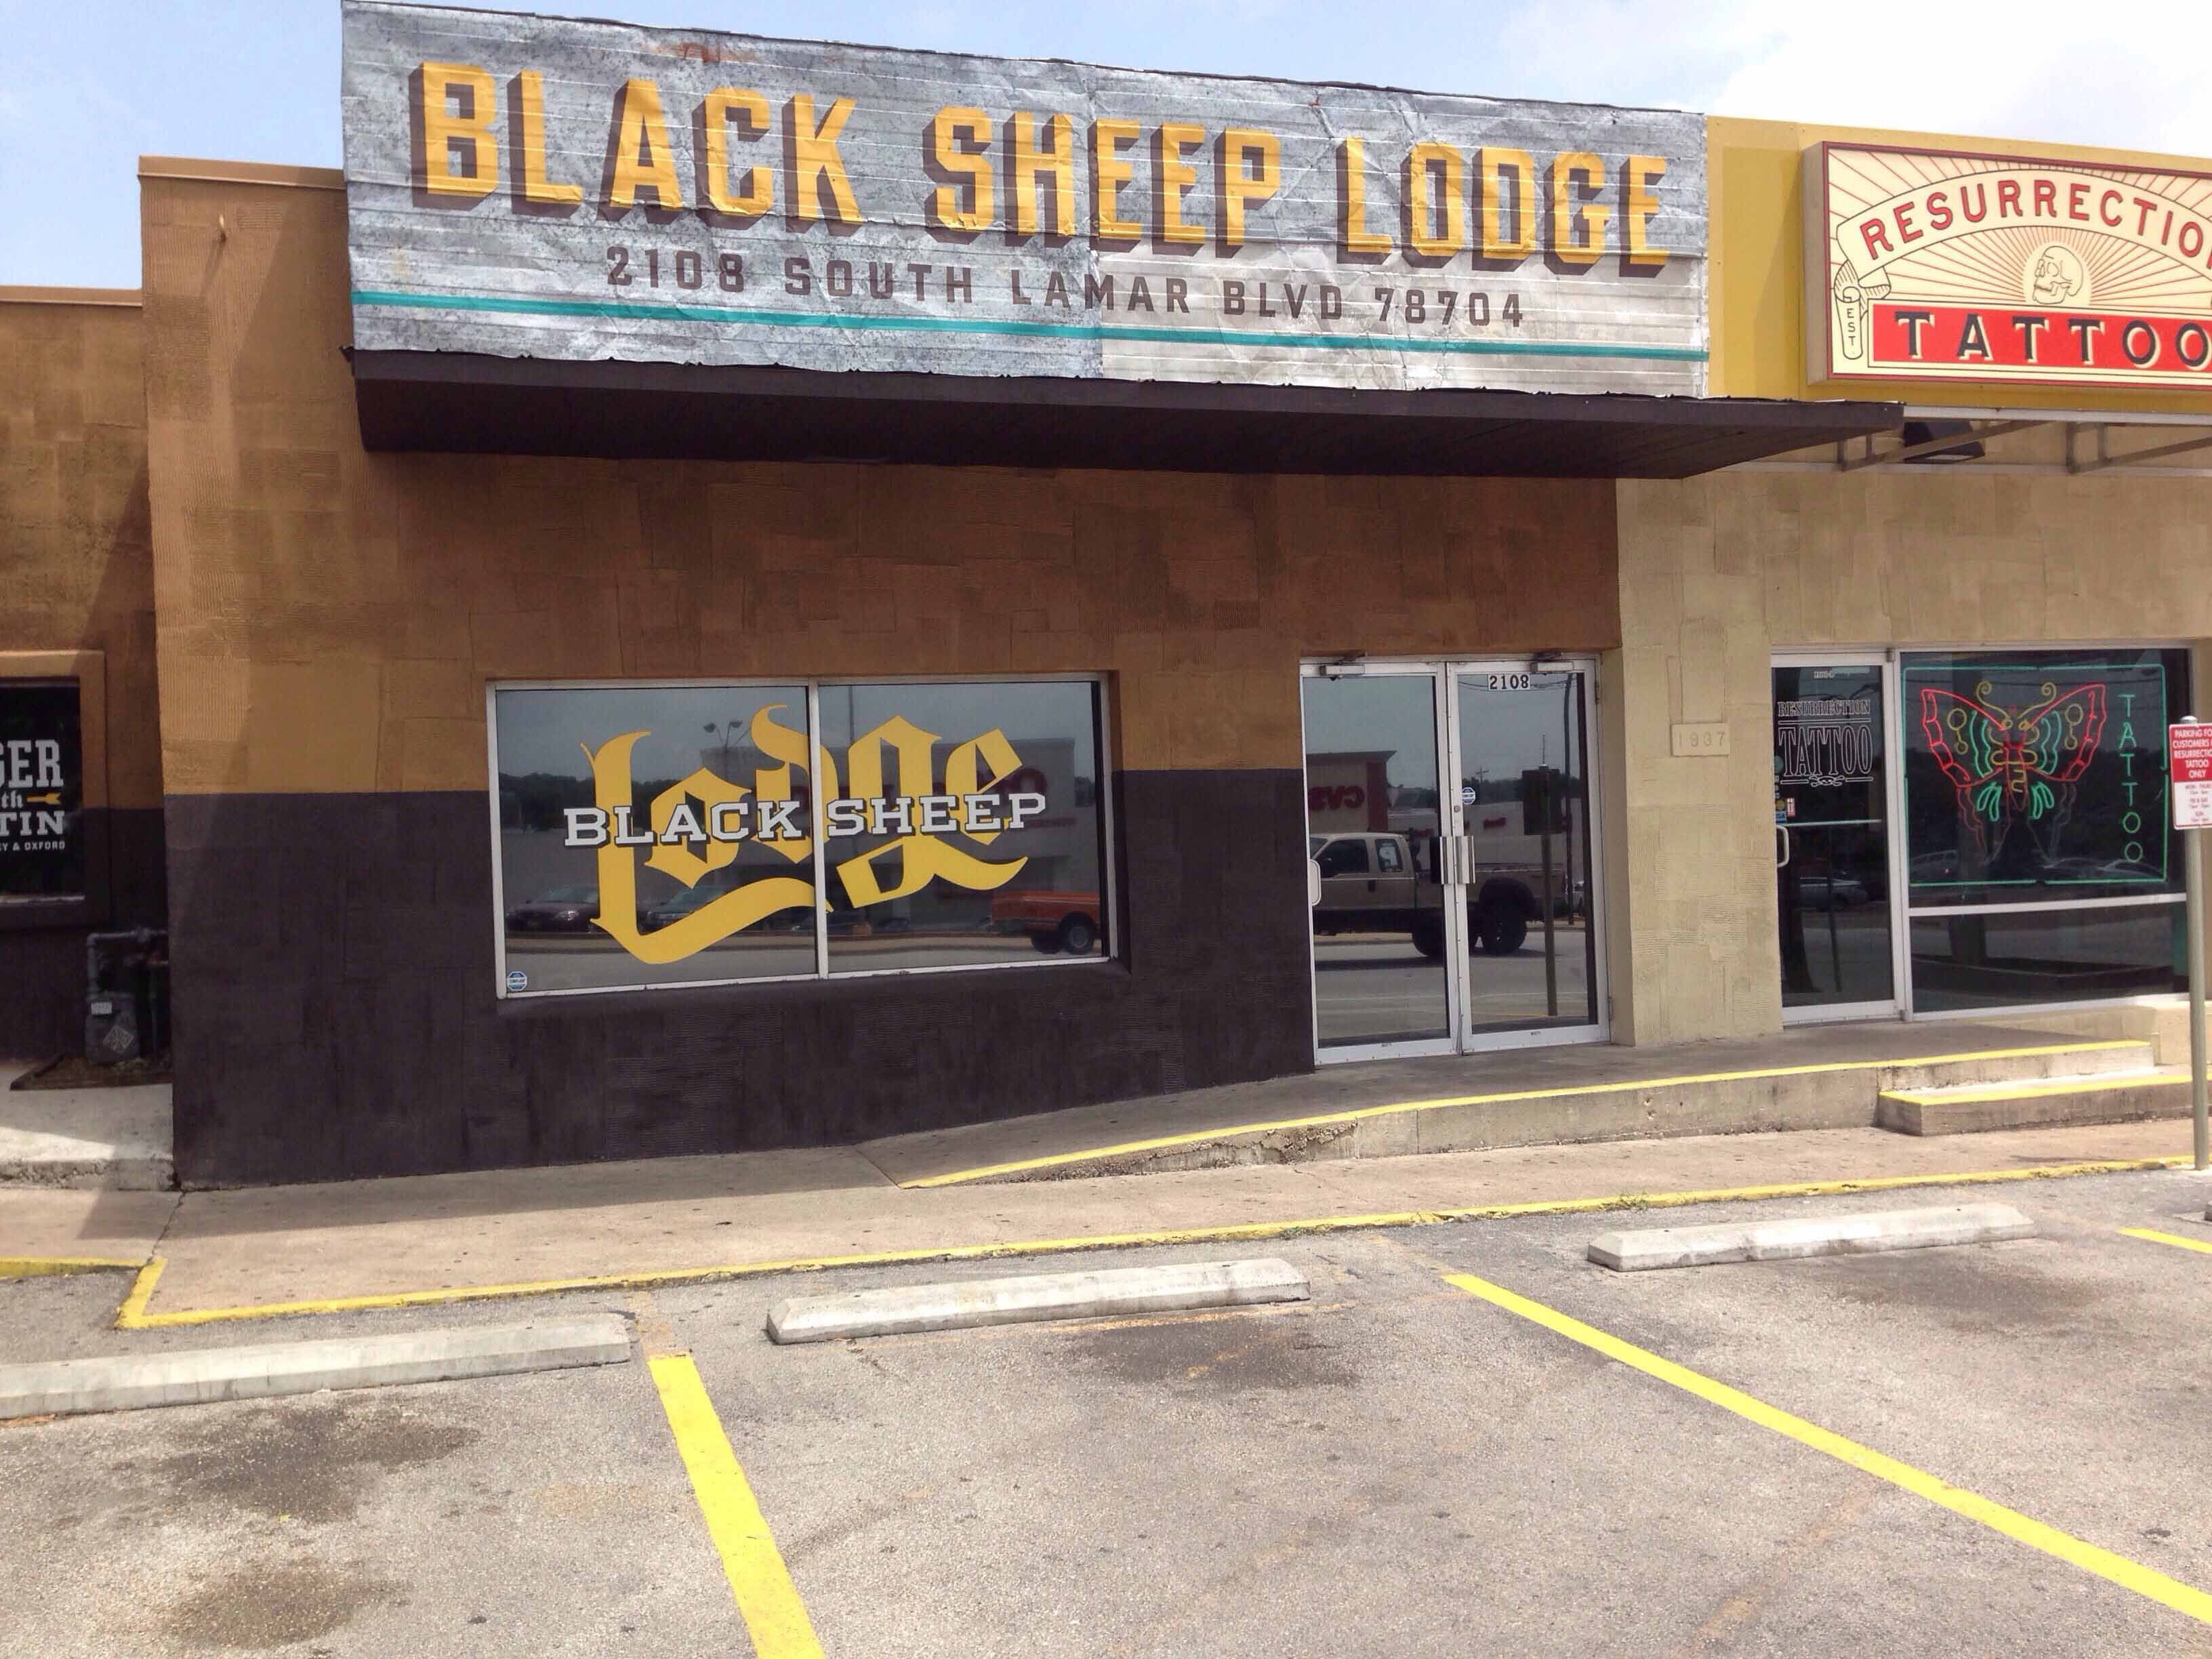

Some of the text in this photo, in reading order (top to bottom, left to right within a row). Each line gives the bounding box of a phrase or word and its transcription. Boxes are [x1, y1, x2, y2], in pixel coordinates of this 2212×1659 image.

[410, 62, 1669, 278] BLACK SHEEP LODGE
[1860, 179, 2212, 270] RESURRECTIO
[607, 246, 1523, 328] 2108 SOUTH LAMAR BLVD 78704
[1845, 308, 1856, 348] EST
[1894, 310, 2212, 371] TATTOO
[1490, 674, 1529, 690] 2108
[1778, 699, 1871, 716] RESURRECTION
[1778, 724, 1872, 777] TATTOO
[2173, 739, 2209, 748] CUSTOMERS
[2175, 729, 2203, 738] PARKING
[0, 739, 64, 788] ER
[2117, 693, 2144, 863] TATTOO
[2185, 759, 2209, 768] TATTOO
[2188, 769, 2207, 779] ONLY
[563, 792, 1046, 847] BLACK SHEEP
[24, 840, 65, 851] OXFORD
